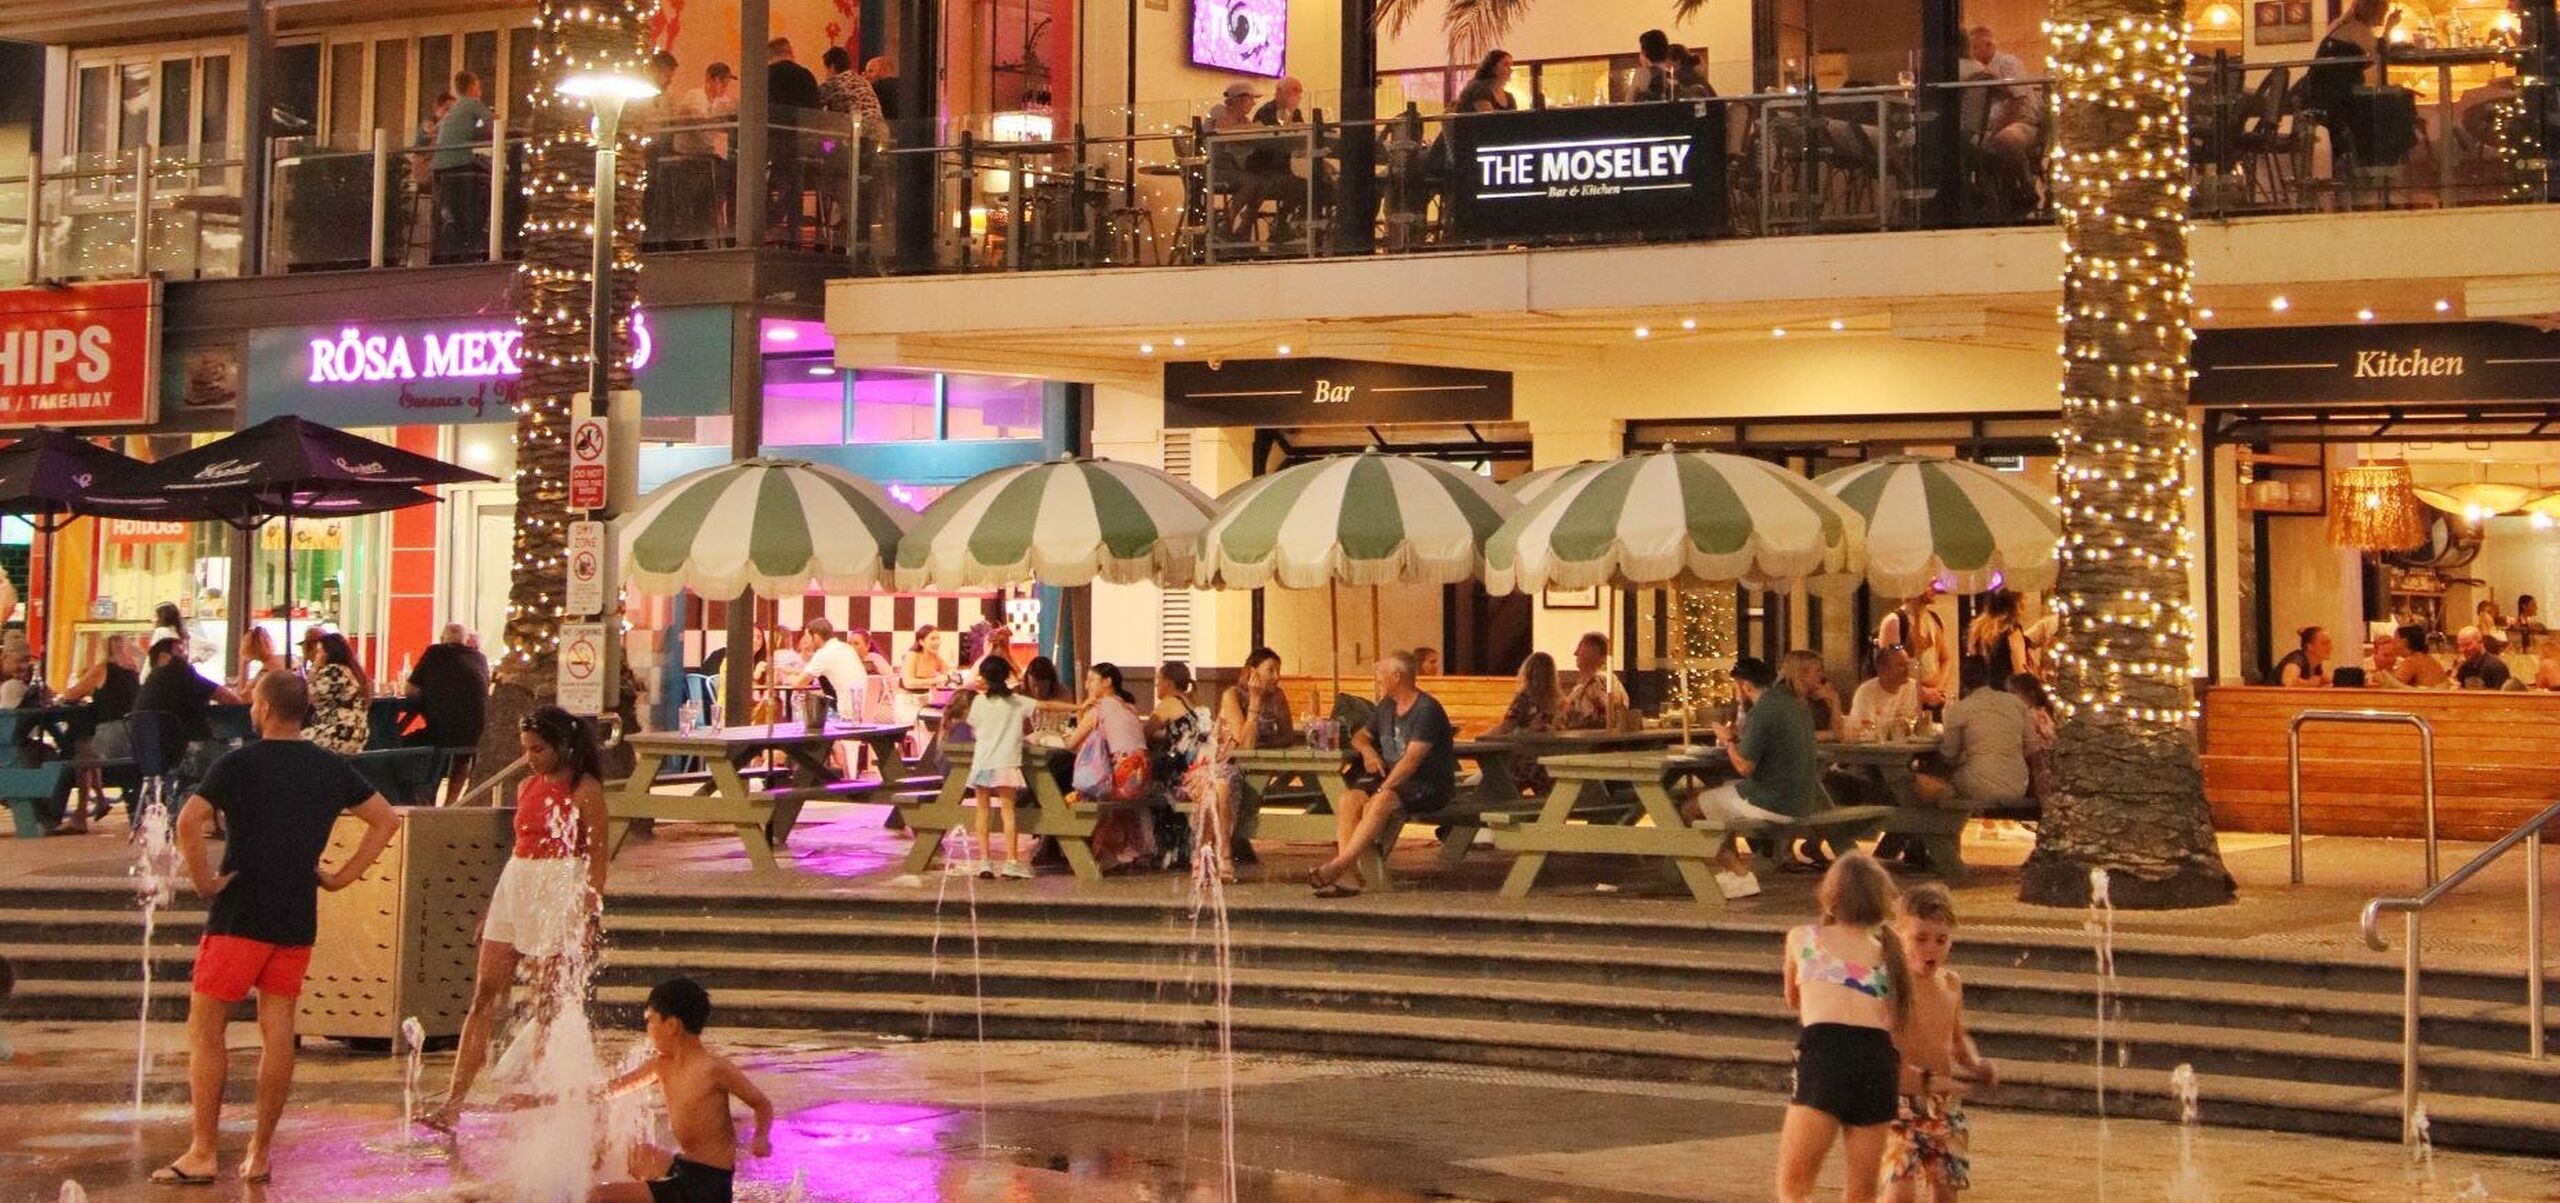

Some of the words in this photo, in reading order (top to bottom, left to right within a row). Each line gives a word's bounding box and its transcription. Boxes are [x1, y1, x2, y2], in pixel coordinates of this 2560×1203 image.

[1477, 154, 1534, 185] THE
[1541, 145, 1691, 182] MOSELEY
[1548, 186, 1568, 198] Bar
[1569, 185, 1581, 196] &
[1581, 184, 1620, 196] Kitchen
[309, 328, 416, 382] RÖSA
[2354, 348, 2465, 378] Kitchen
[29, 391, 113, 411] TAKEAWAY
[1313, 379, 1356, 403] Bar
